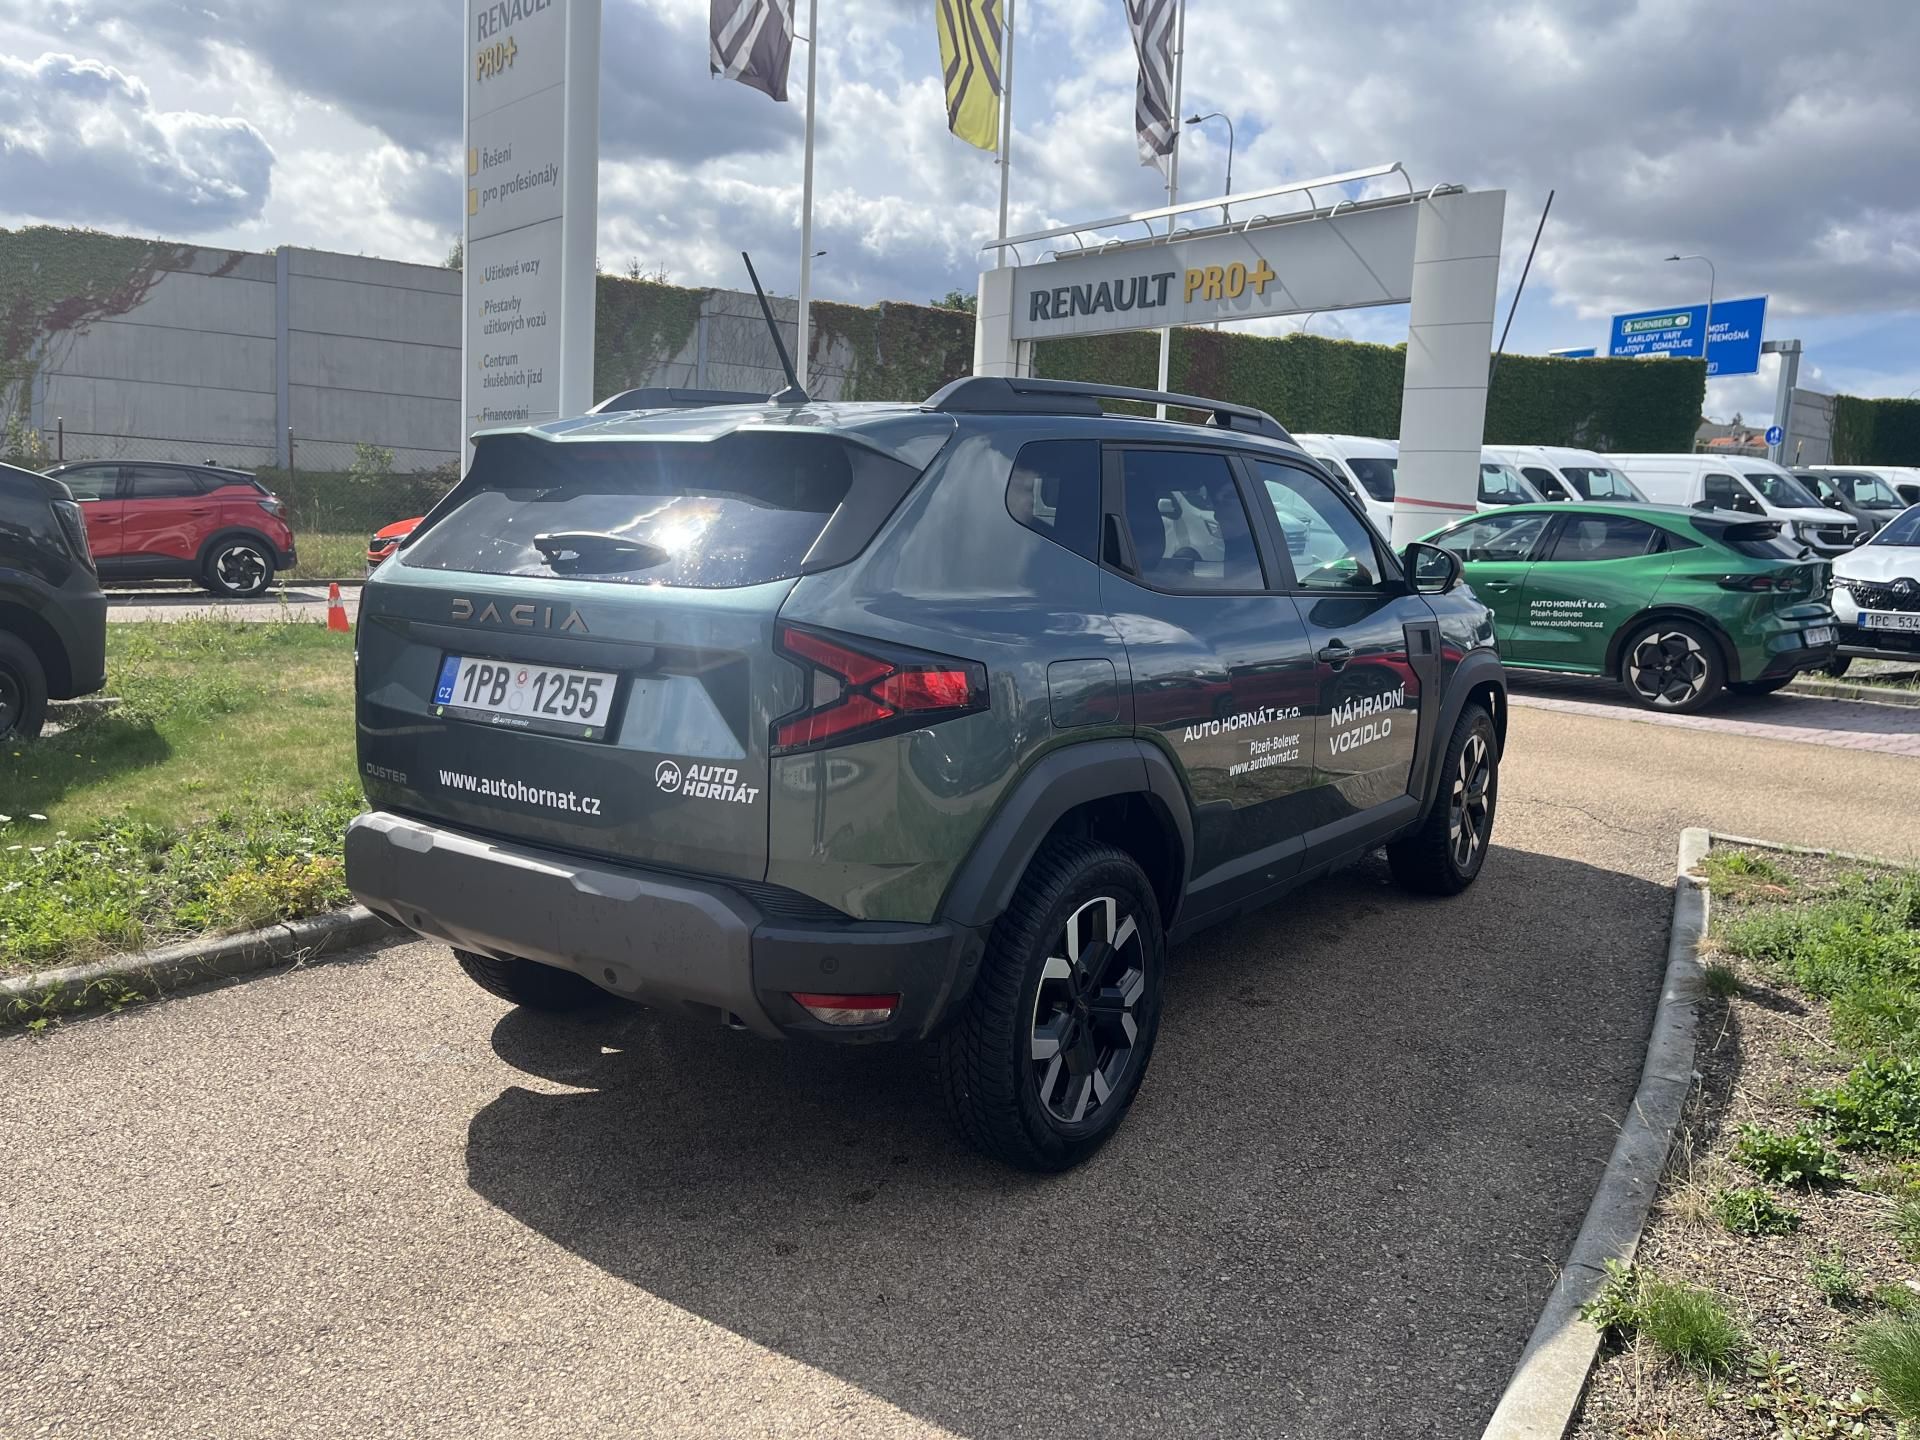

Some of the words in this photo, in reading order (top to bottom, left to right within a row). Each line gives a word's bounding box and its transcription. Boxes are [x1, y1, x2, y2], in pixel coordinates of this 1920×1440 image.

[477, 36, 517, 81] PRO+
[483, 143, 512, 169] Řešení
[482, 186, 497, 208] pro
[500, 162, 559, 201] profesionály
[484, 260, 519, 281] Užitkové
[521, 259, 540, 276] vozy
[1029, 271, 1175, 322] RENAULT
[1184, 259, 1275, 304] PRO+
[484, 295, 522, 315] Přestavby
[483, 314, 525, 335] užitkových
[526, 310, 546, 329] vozů
[1633, 318, 1672, 330] NÜRNBERG
[1708, 323, 1729, 332] MOST
[1615, 344, 1645, 354] KLATOVY
[1652, 338, 1693, 351] DOMAŽLICE
[1627, 334, 1660, 344] KARLOVY
[1663, 330, 1682, 340] VARY
[483, 353, 518, 368] Centrum
[483, 370, 525, 388] zkušebních
[527, 367, 543, 389] jízd
[483, 404, 529, 421] Financování
[1530, 609, 1583, 618] Plzeň-Bolevec
[1531, 600, 1552, 608] AUTO
[1553, 599, 1587, 608] HORNÁT
[1587, 600, 1607, 609] s.r.o.
[452, 598, 590, 633] DACIA
[1530, 620, 1604, 628] www.autohornat.cz
[1869, 615, 1889, 627] 1PC
[438, 687, 451, 699] CZ
[463, 663, 511, 706] 1PB
[532, 671, 603, 719] 1255
[1330, 681, 1406, 728] NÁHRADNÍ
[1183, 719, 1220, 743] AUTO
[1222, 705, 1276, 734] HORNÁT
[1276, 705, 1301, 721] s.r.o.
[1250, 732, 1300, 756] Plzeň-Bolevec
[1329, 718, 1392, 756] VOZIDLO
[366, 762, 408, 785] DUSTER
[1229, 748, 1299, 777] www.autohornat.cz
[686, 764, 738, 785] AUTO
[439, 769, 601, 815] www.autohornat.cz
[682, 780, 760, 804] HORNÁT
